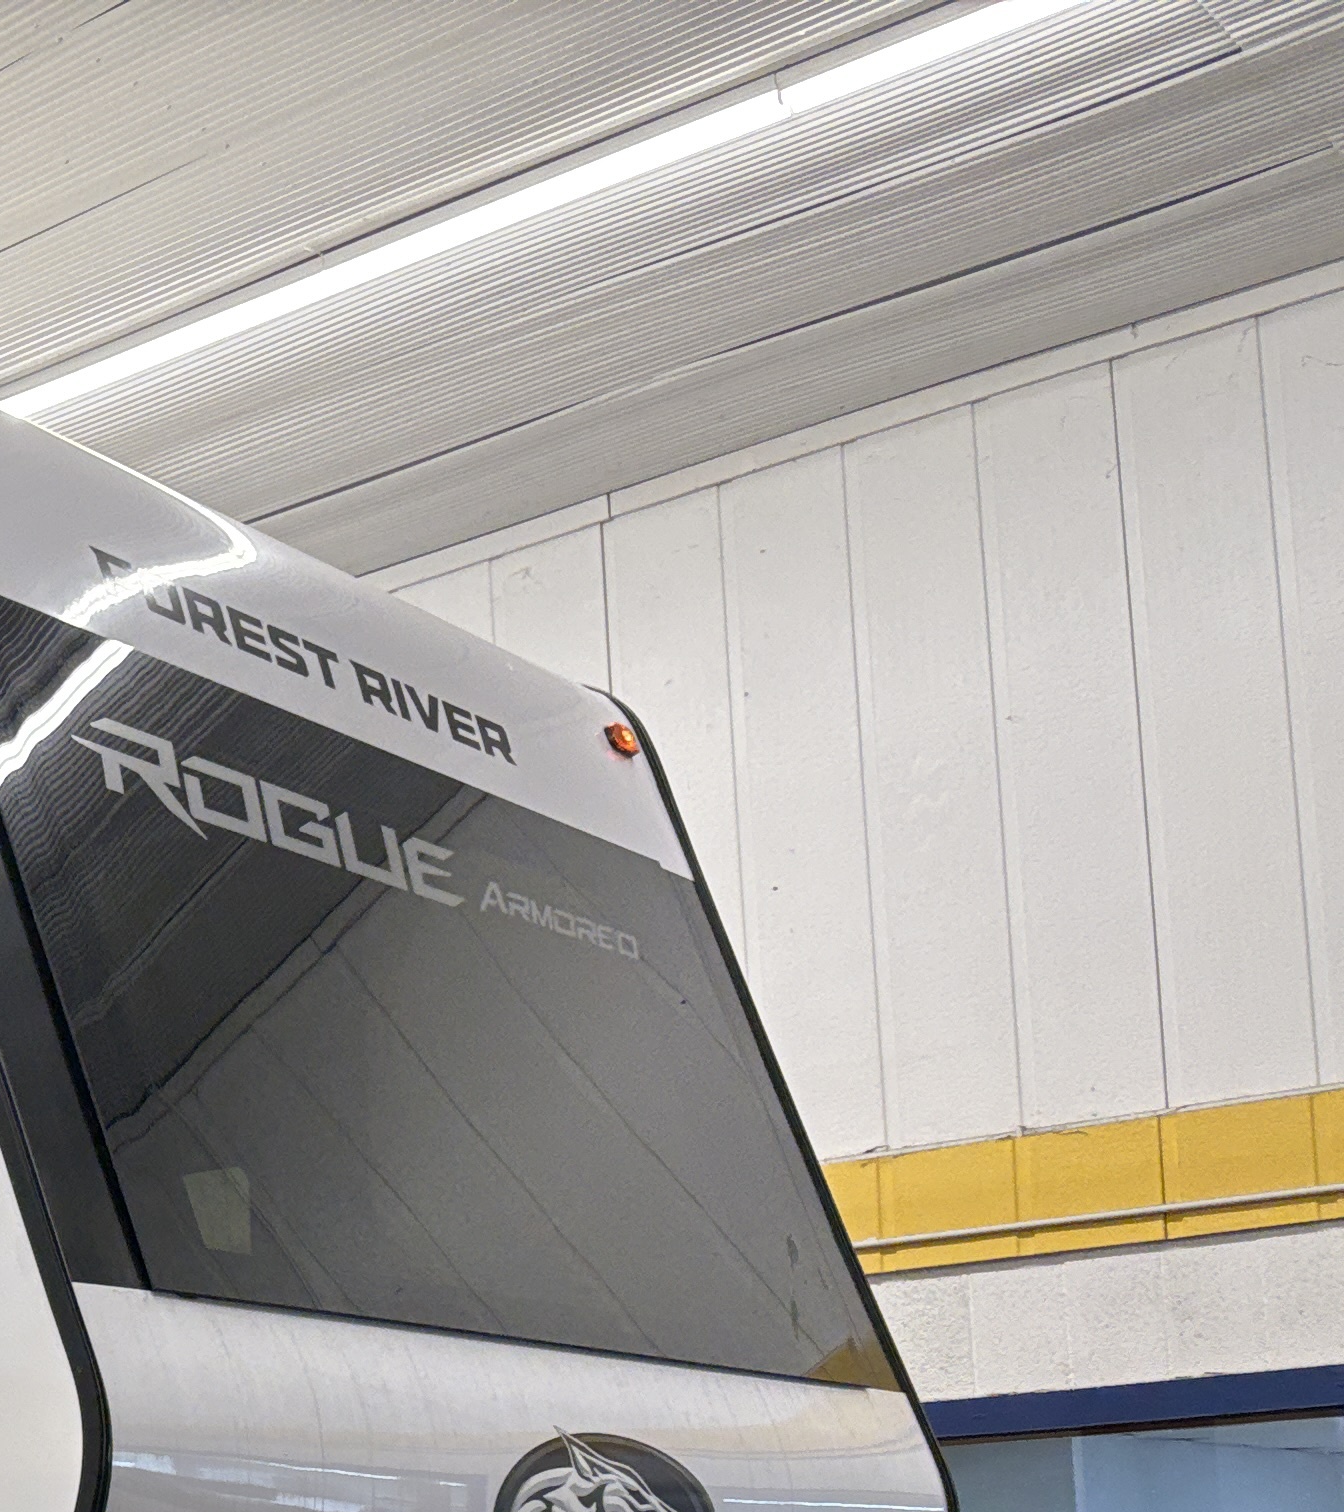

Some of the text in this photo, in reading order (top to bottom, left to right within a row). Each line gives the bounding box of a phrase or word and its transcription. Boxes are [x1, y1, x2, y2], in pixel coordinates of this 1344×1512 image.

[349, 658, 517, 766] RIVER
[70, 717, 640, 960] ROGUE ARMORED
